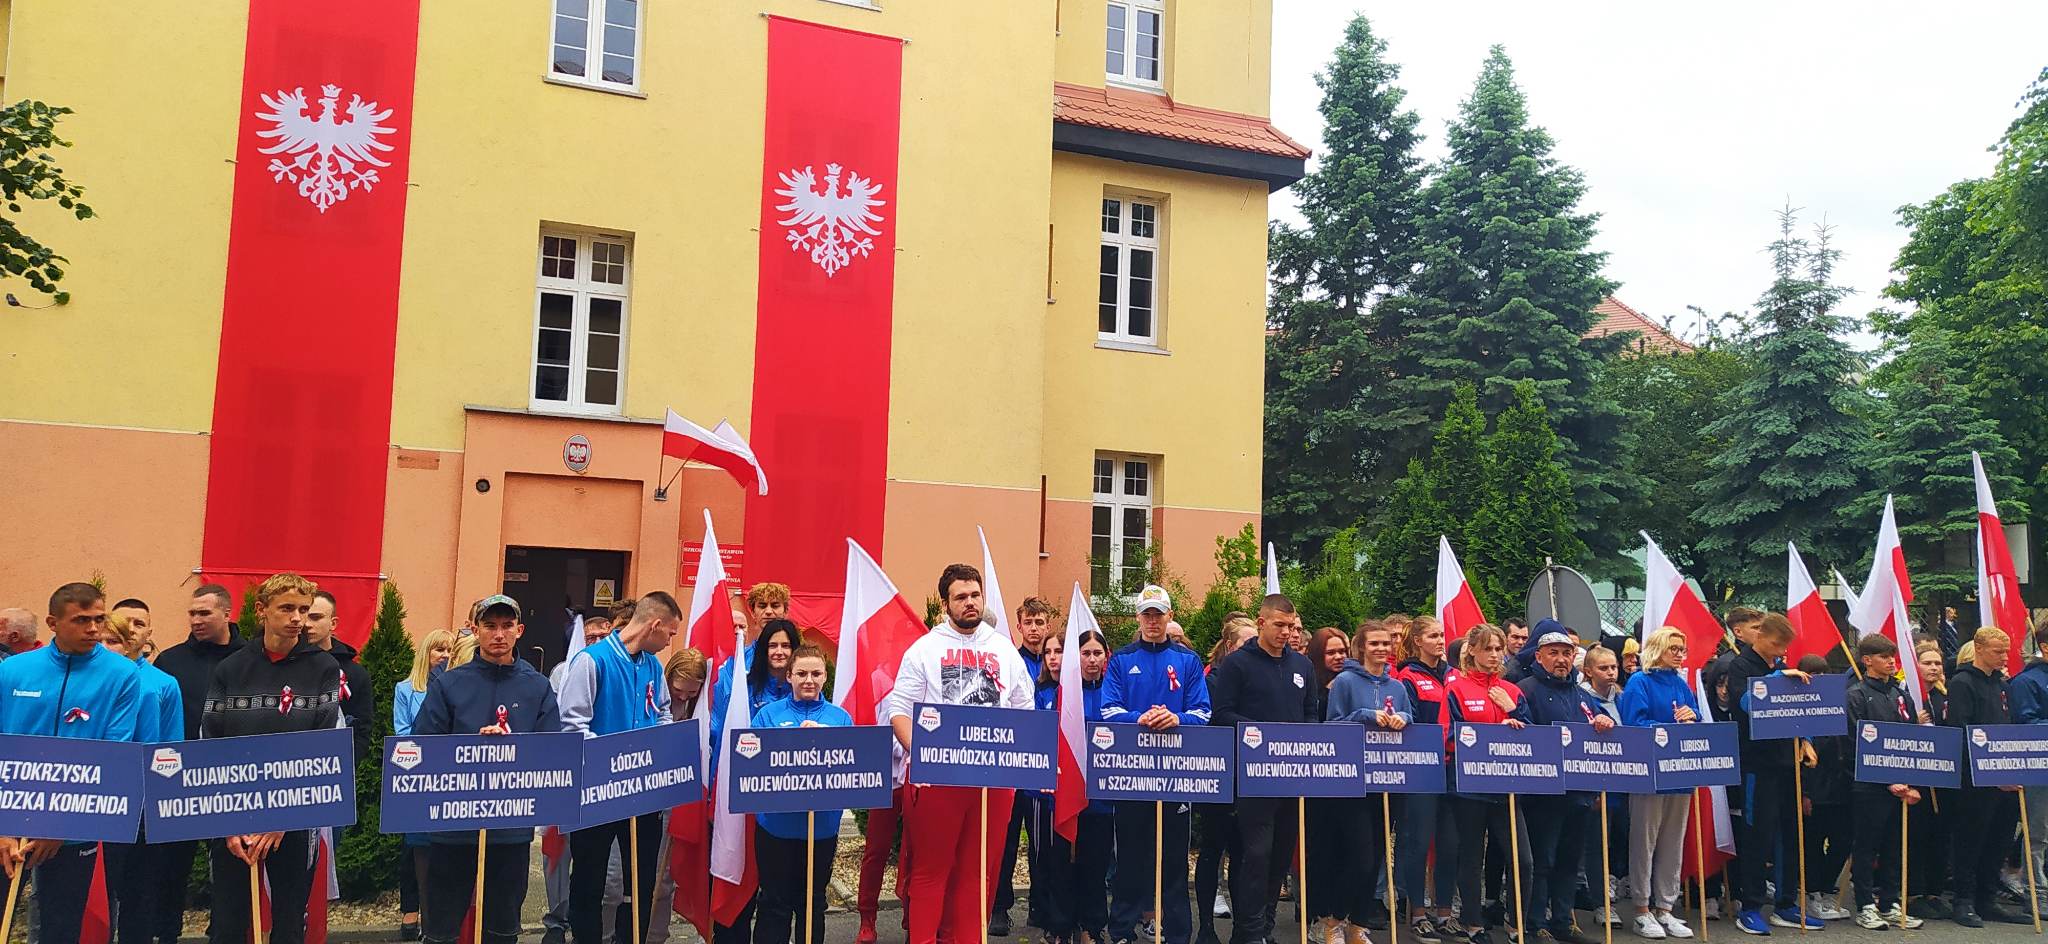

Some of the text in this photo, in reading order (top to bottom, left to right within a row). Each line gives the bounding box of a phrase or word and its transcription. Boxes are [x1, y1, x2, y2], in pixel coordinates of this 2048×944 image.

[940, 648, 1000, 668] JAWS
[1770, 693, 1821, 703] MAZOWIECKA
[1752, 706, 1845, 718] WOJEWÓDZKA KOMENDA
[960, 725, 1015, 744] LUBELSKA
[1137, 732, 1183, 748] CENTRUM
[1366, 731, 1402, 745] CENTRUM
[455, 744, 517, 764] CENTRUM
[1268, 741, 1336, 757] PODKARPACKA
[1489, 742, 1533, 757] POMORSKA
[1583, 740, 1623, 756] PODLASKA
[1680, 739, 1710, 752] LUBUSKA
[1883, 738, 1935, 753] MAŁOPOLSKA
[610, 750, 653, 774] ŁÓDZKA
[770, 747, 855, 769] DOLNOŚLĄSKA
[920, 746, 1050, 769] WOJEWÓDZKA KOMENDA
[1093, 753, 1226, 772] KSZTAŁCENIA I WYCHOWANIA
[1364, 750, 1381, 764] ENIA
[1386, 751, 1440, 765] WYCHOWANIA
[1658, 756, 1735, 772] WOJEWÓDZKA KOMENDA
[1863, 754, 1955, 772] WOJEWÓDZKA KOMENDA
[1976, 756, 2027, 770] WOJEWÓDZKA
[156, 763, 180, 771] OHP
[182, 756, 342, 787] KUJAWSKO-POMORSKA
[1246, 761, 1358, 778] WOJEWÓDZKA KOMENDA
[1463, 760, 1558, 778] WOJEWÓDZKA KOMENDA
[1611, 761, 1649, 776] KOMENDA
[392, 769, 573, 793] KSZTAŁCENIA I WYCHOWANIA
[644, 765, 695, 792] KOMENDA
[739, 772, 883, 793] WOJEWÓDZKA KOMENDA
[1099, 776, 1220, 793] w SZCZAWNICY/JABŁONCE
[1372, 771, 1406, 785] GOŁDAPI
[0, 786, 128, 816] DZKA KOMENDA
[158, 783, 343, 818] WOJEWÓDZKA KOMENDA
[429, 798, 536, 820] w DOBIESZKOWIE
